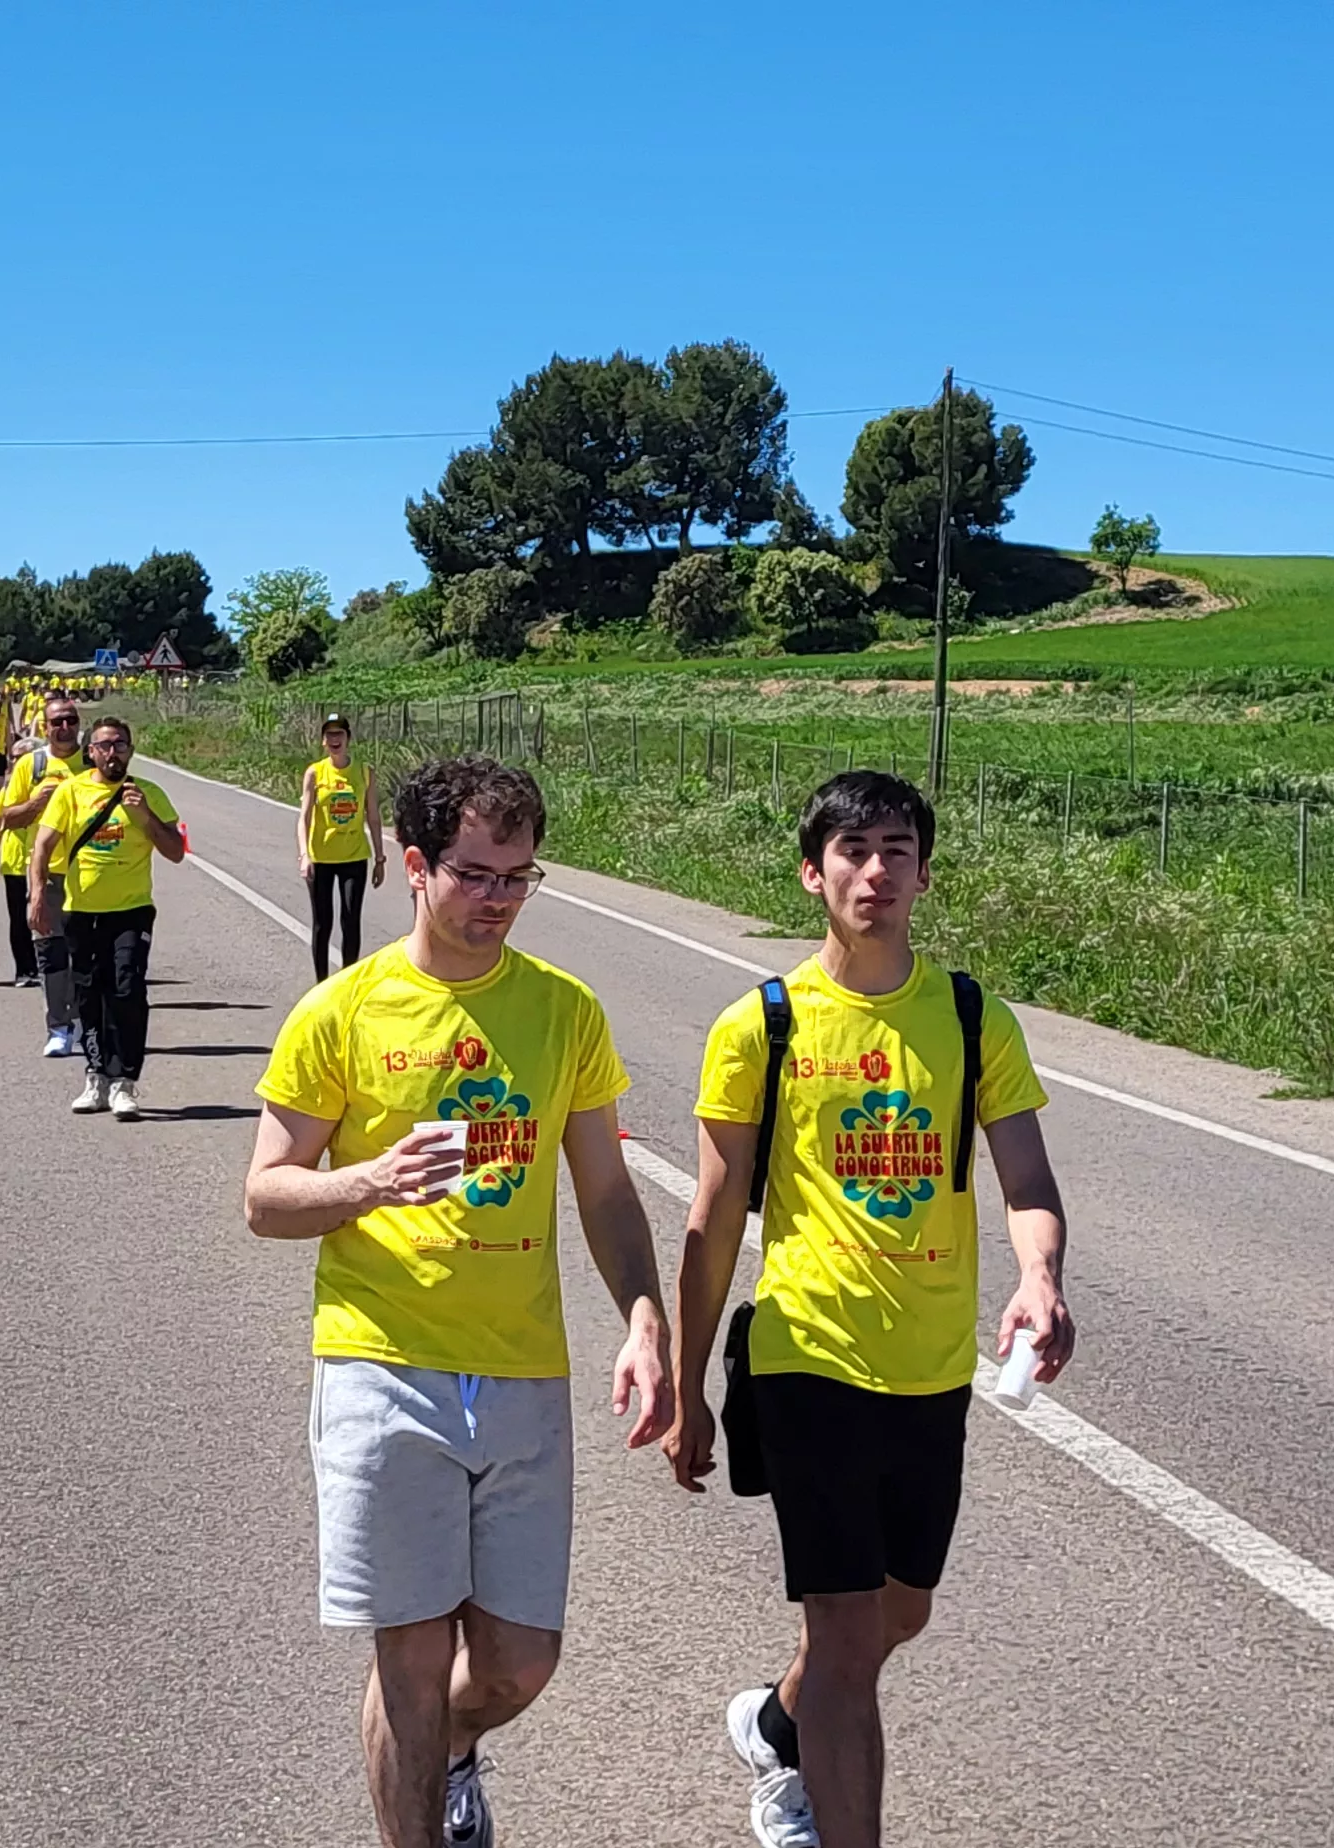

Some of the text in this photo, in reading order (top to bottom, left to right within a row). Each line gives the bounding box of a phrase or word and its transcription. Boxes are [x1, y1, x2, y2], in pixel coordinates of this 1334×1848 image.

[380, 1051, 407, 1073] 13
[789, 1058, 814, 1079] 13
[467, 1119, 519, 1144] UERTE
[835, 1132, 942, 1154] LA SUERTE DE
[466, 1142, 536, 1167] OCERNOS
[834, 1155, 944, 1177] CONOCERNOS
